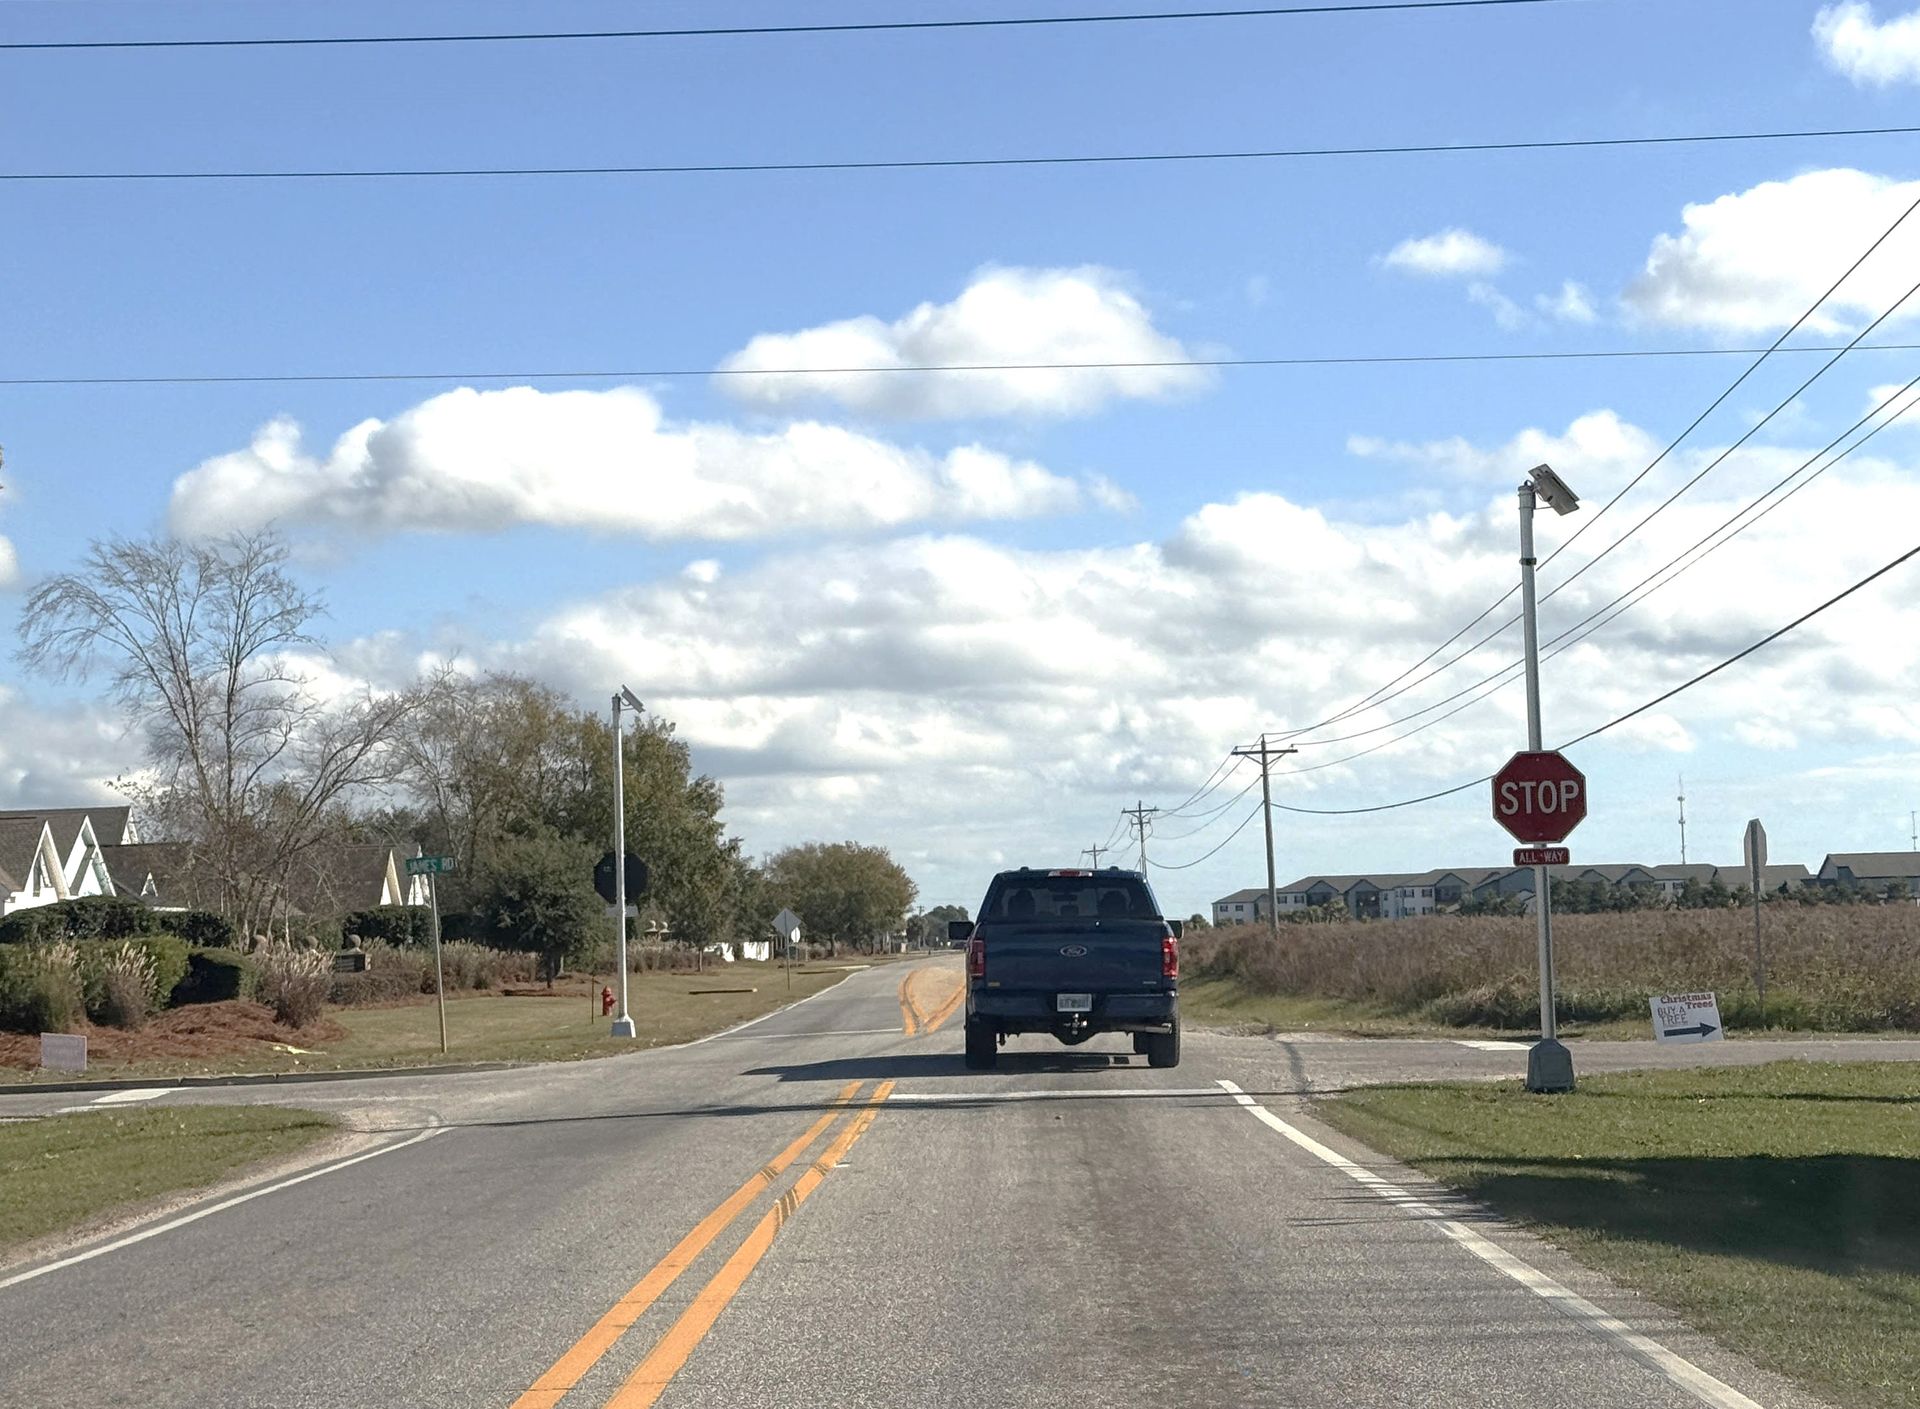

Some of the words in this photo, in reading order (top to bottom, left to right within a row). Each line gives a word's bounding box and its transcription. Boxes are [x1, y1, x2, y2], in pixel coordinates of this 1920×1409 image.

[1500, 780, 1579, 815] STOP
[1520, 852, 1537, 863] ALL
[1543, 850, 1564, 862] WAY
[442, 857, 454, 870] RD
[1661, 993, 1712, 1004] Christmas
[1685, 1001, 1713, 1009] Trees
[1661, 1014, 1688, 1025] TREE
